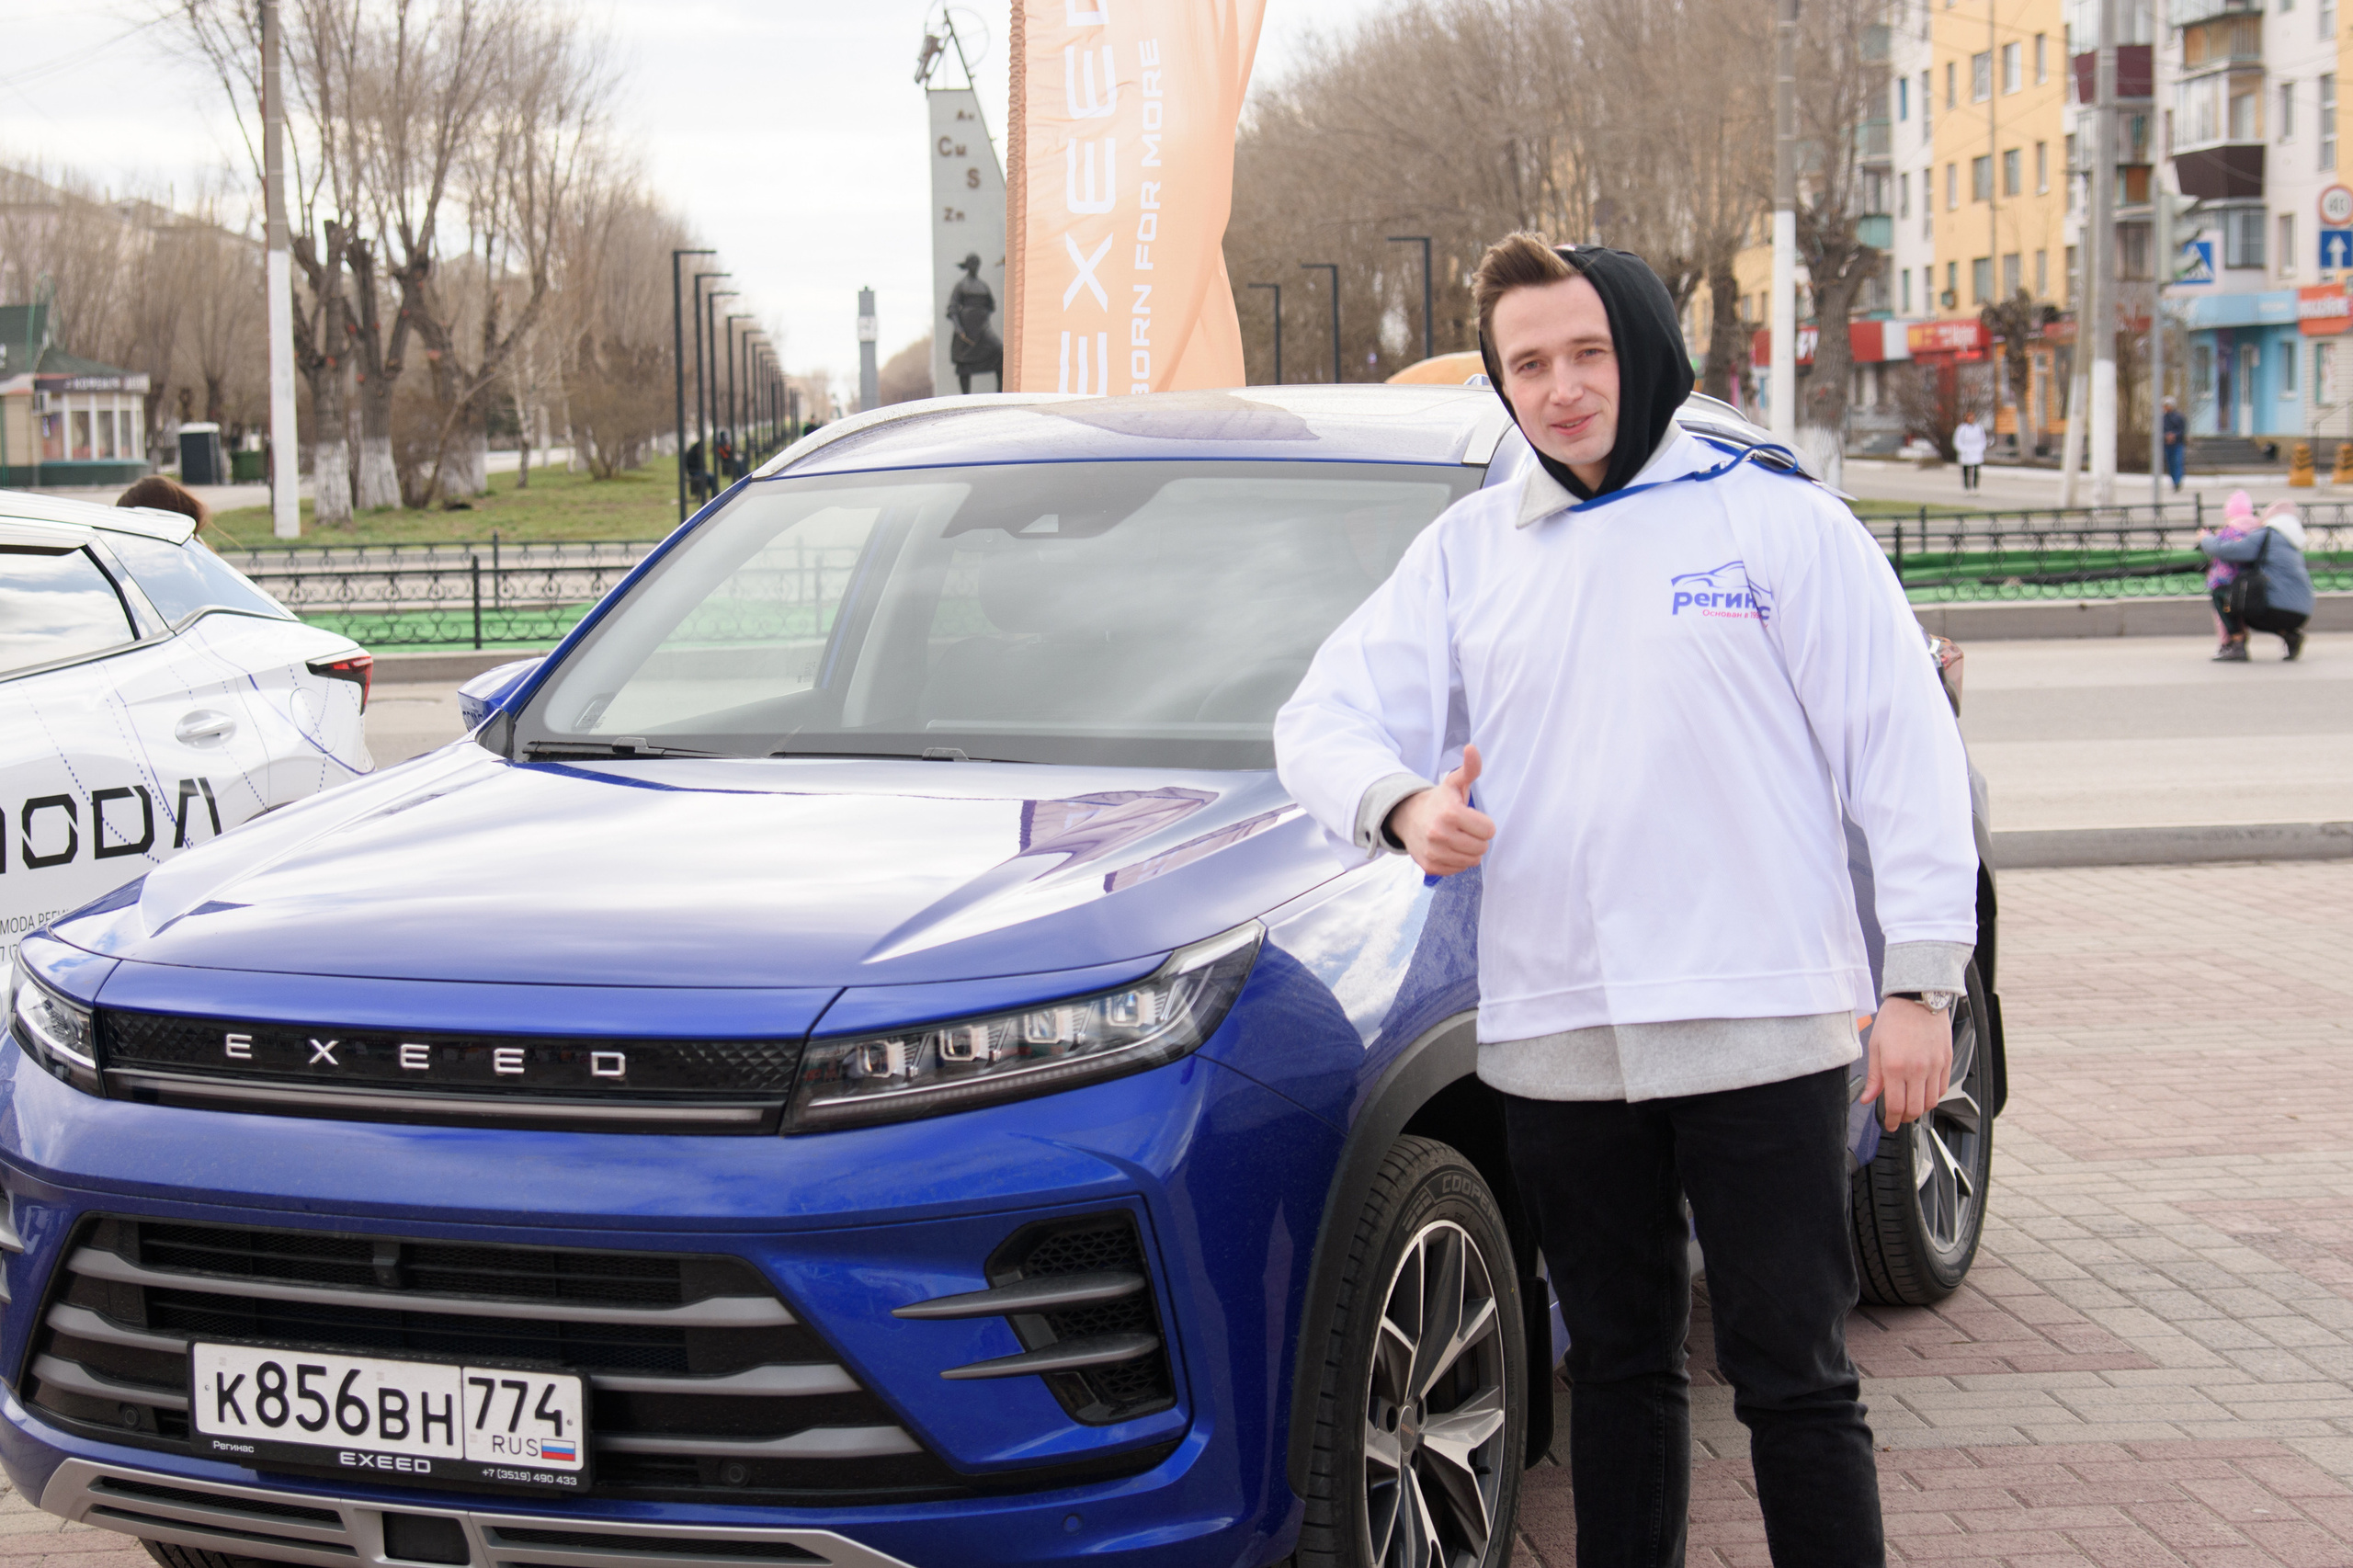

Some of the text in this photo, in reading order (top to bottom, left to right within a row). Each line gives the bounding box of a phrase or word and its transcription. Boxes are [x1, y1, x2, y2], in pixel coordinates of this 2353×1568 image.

[1138, 38, 1163, 167] MORE
[938, 136, 966, 157] Cu
[967, 167, 980, 188] S
[1134, 181, 1161, 270] FOR
[1672, 592, 1770, 620] регинс
[0, 778, 222, 873] ODA
[226, 1033, 627, 1079] EXEED
[468, 1377, 563, 1437] 774
[213, 1440, 255, 1453] Регинас
[492, 1435, 539, 1458] RUS
[339, 1451, 431, 1473] EXEED
[483, 1469, 577, 1486] +7 (3519) 490 433
